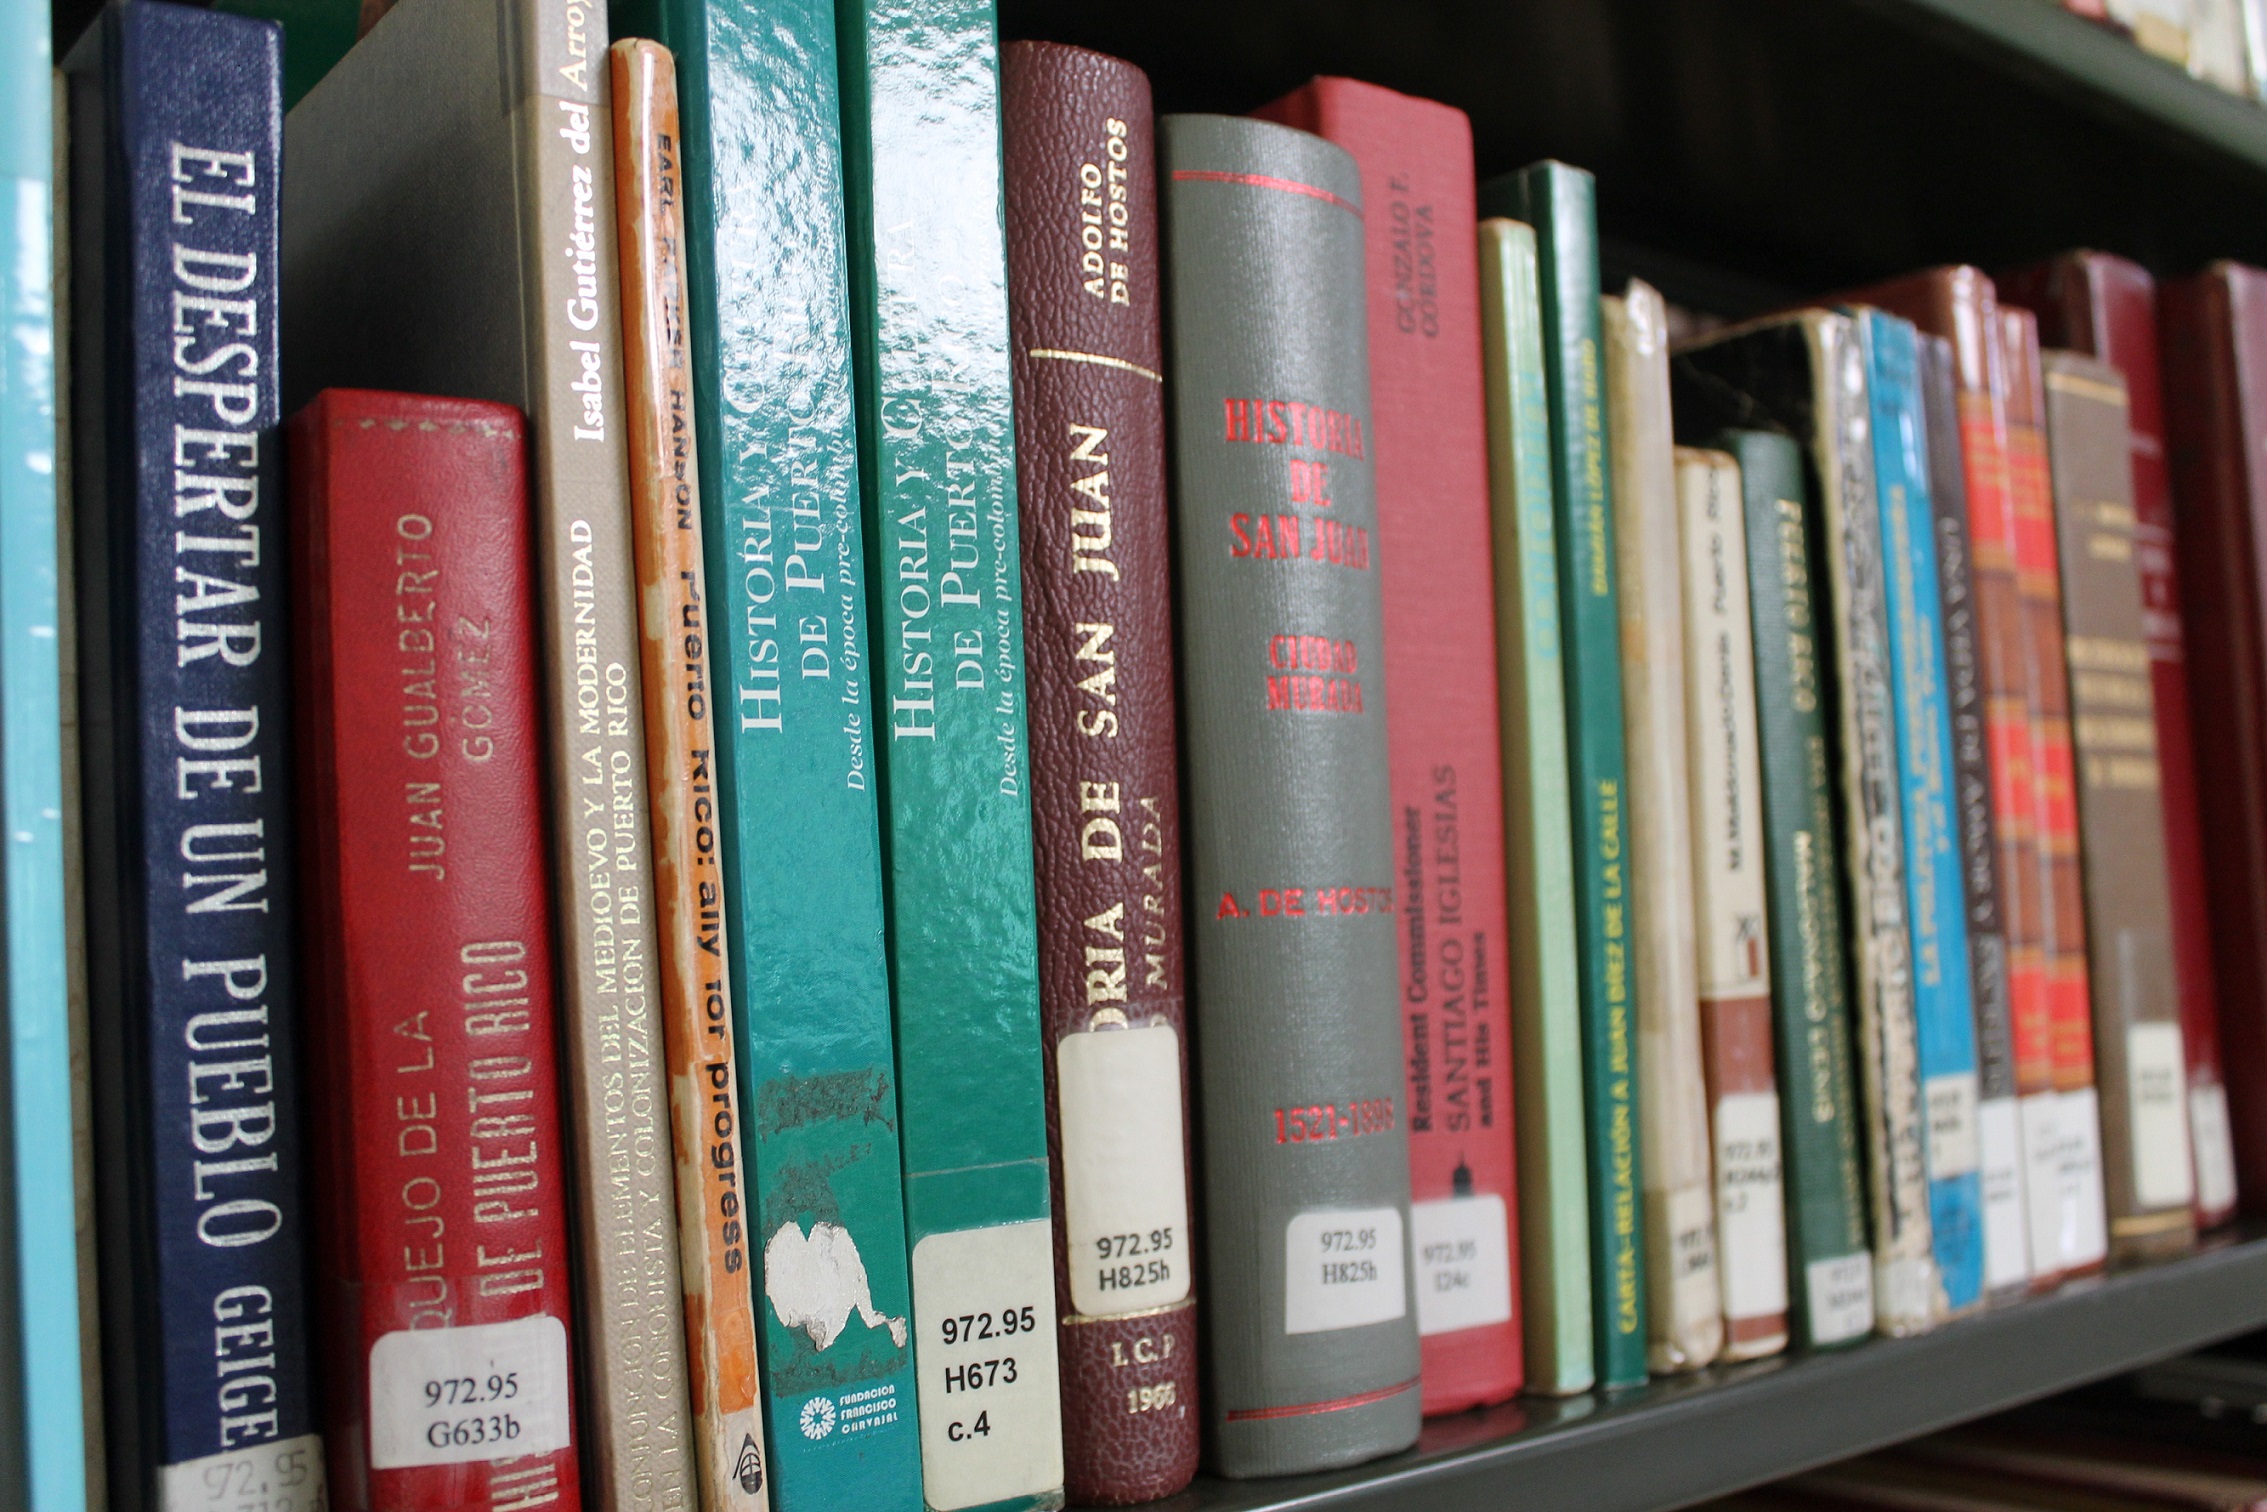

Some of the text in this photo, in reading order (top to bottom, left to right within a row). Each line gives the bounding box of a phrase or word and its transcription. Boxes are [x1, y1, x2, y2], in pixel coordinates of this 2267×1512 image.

[560, 102, 591, 155] del
[170, 142, 256, 225] EL
[1106, 116, 1130, 308] DE HOSTOS
[565, 165, 601, 332] Gutiérrez
[1081, 162, 1105, 301] ADOLFO
[574, 340, 605, 443] Isabel
[172, 243, 262, 669] DESPERTAR
[738, 442, 768, 471] Y
[1223, 398, 1365, 462] HISTORIA
[784, 391, 825, 594] PUERTO
[895, 459, 927, 488] Y
[1069, 424, 1120, 583] JUAN
[1289, 458, 1332, 507] DE
[940, 416, 981, 609] PUERTO
[1229, 512, 1369, 570] SAN JUAN
[738, 486, 784, 734] HISTORIA
[838, 595, 862, 671] época
[892, 506, 936, 742] HISTORIA
[801, 614, 831, 680] DE
[954, 630, 985, 692] DE
[992, 608, 1014, 683] época
[1268, 634, 1358, 674] CIUDAD
[397, 514, 446, 881] JUAN GUALBERTO
[842, 681, 859, 706] la
[996, 691, 1014, 716] la
[1075, 622, 1118, 739] SAN
[1266, 675, 1364, 714] MURADA
[175, 706, 262, 799] DE
[846, 715, 867, 792] Desde
[1000, 716, 1019, 798] Desde
[670, 388, 692, 531] HANSON
[704, 1061, 743, 1276] progress
[1080, 780, 1124, 864] DE
[1599, 779, 1621, 860] CALLE
[178, 818, 268, 914] UN
[1602, 863, 1622, 898] LA
[1216, 891, 1250, 920] A.
[1258, 888, 1307, 917] DE
[1603, 902, 1623, 939] DE
[1402, 805, 1434, 1134] Resident Commissioner
[1433, 763, 1472, 1133] SANTIAGO IGLESIAS
[461, 940, 530, 1034] RICO
[570, 519, 653, 1510] CONJUNCION DE ELEMENTOS DEL MEDIOEVO Y LA MODERNIDAD
[396, 1010, 437, 1076] LA
[1469, 931, 1495, 1128] and His Times
[1608, 1008, 1630, 1074] JUAN
[183, 954, 282, 1248] PUEBLO
[605, 662, 684, 1512] EN LA CONQUISTA Y COLONIZACION DE PUERTO RICO
[1610, 1078, 1629, 1100] A
[398, 1092, 438, 1158] DE
[467, 1056, 540, 1224] PUERTO
[476, 1237, 545, 1298] DE
[1096, 1228, 1174, 1261] 972.95
[1320, 1230, 1378, 1255] 972.95
[1321, 1261, 1378, 1286] H825h
[1098, 1260, 1171, 1292] H825h
[941, 1306, 1036, 1346] 972.95
[424, 1372, 519, 1407] 972.95
[839, 1383, 896, 1407] FUNDACION
[944, 1357, 1018, 1394] H673
[427, 1413, 521, 1449] G633b
[840, 1397, 897, 1421] FRANCISCO
[841, 1411, 899, 1435] CARVAJAL
[947, 1411, 991, 1442] c.4
